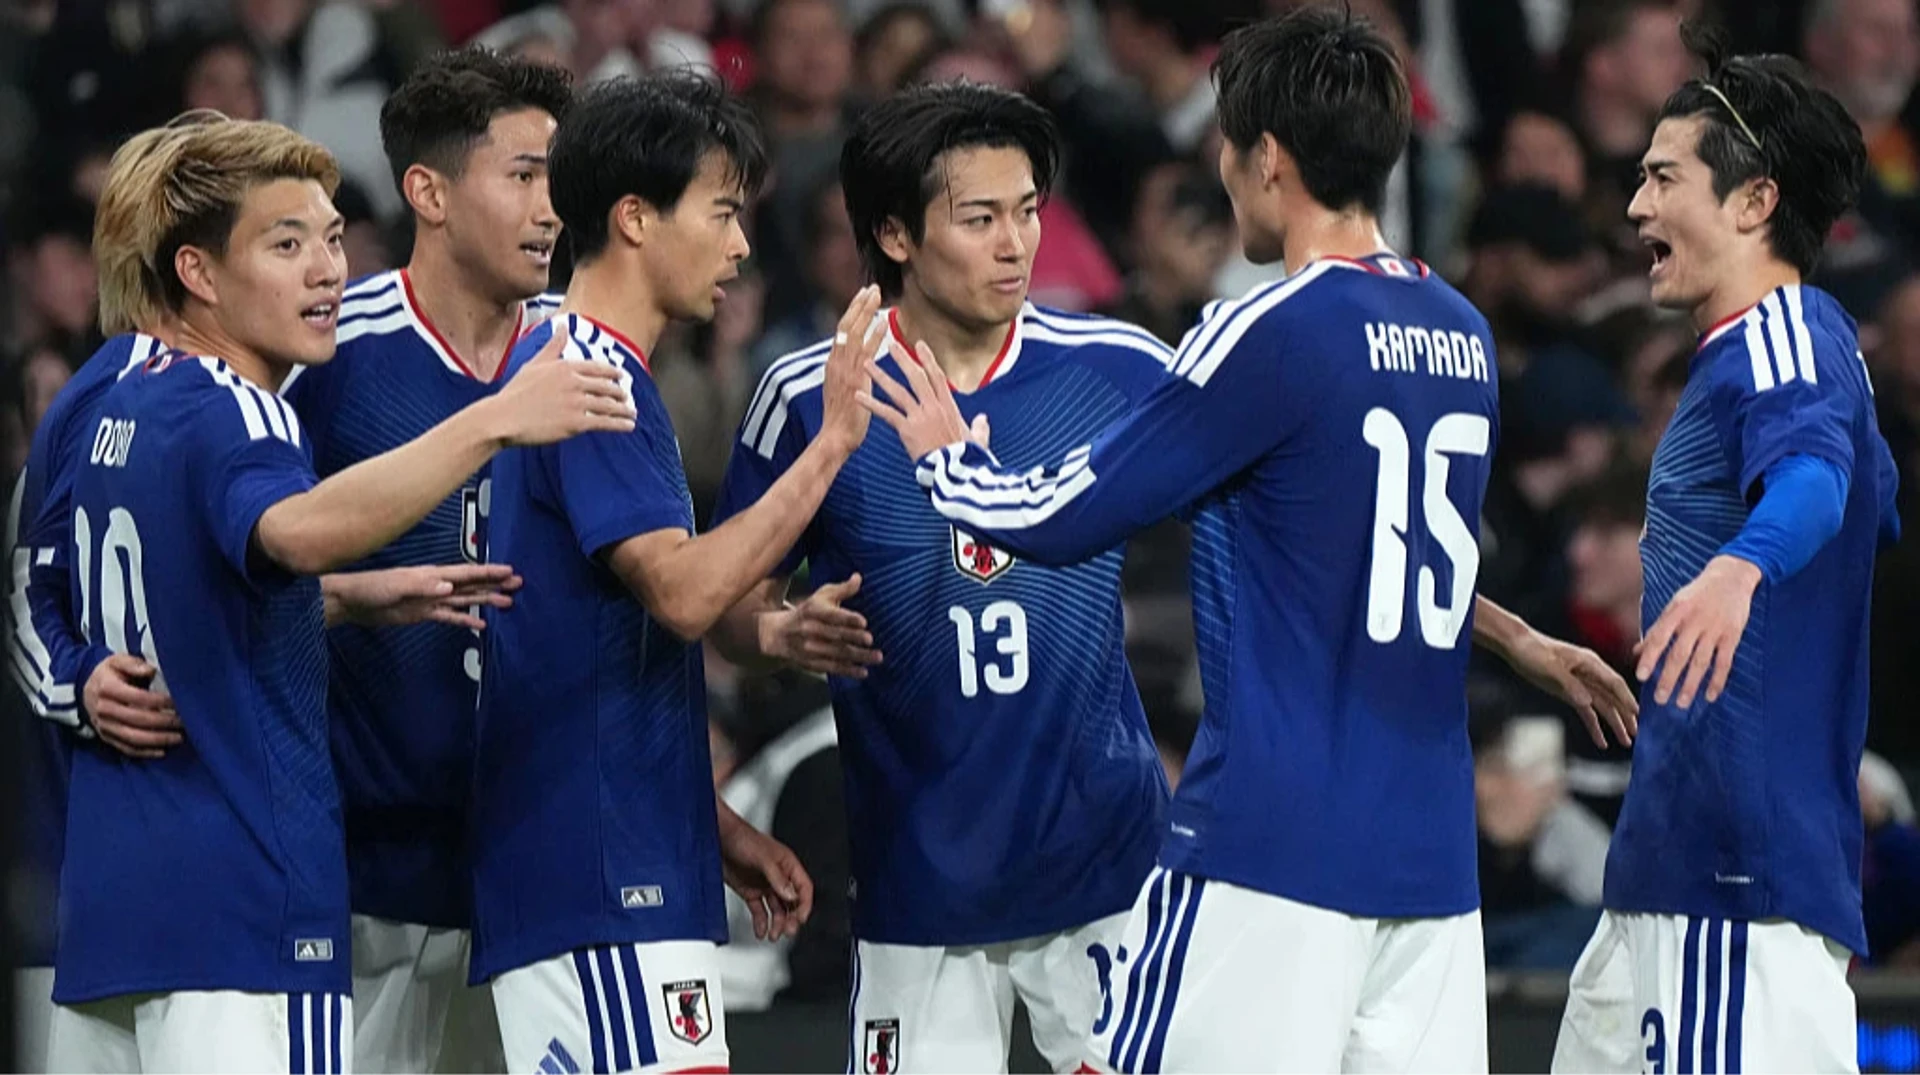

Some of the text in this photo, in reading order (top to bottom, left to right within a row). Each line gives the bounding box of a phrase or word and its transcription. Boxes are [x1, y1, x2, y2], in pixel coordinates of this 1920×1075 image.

[1364, 322, 1489, 383] KAMADA
[1362, 406, 1490, 649] 15
[75, 505, 170, 698] 10
[949, 600, 1030, 698] 13
